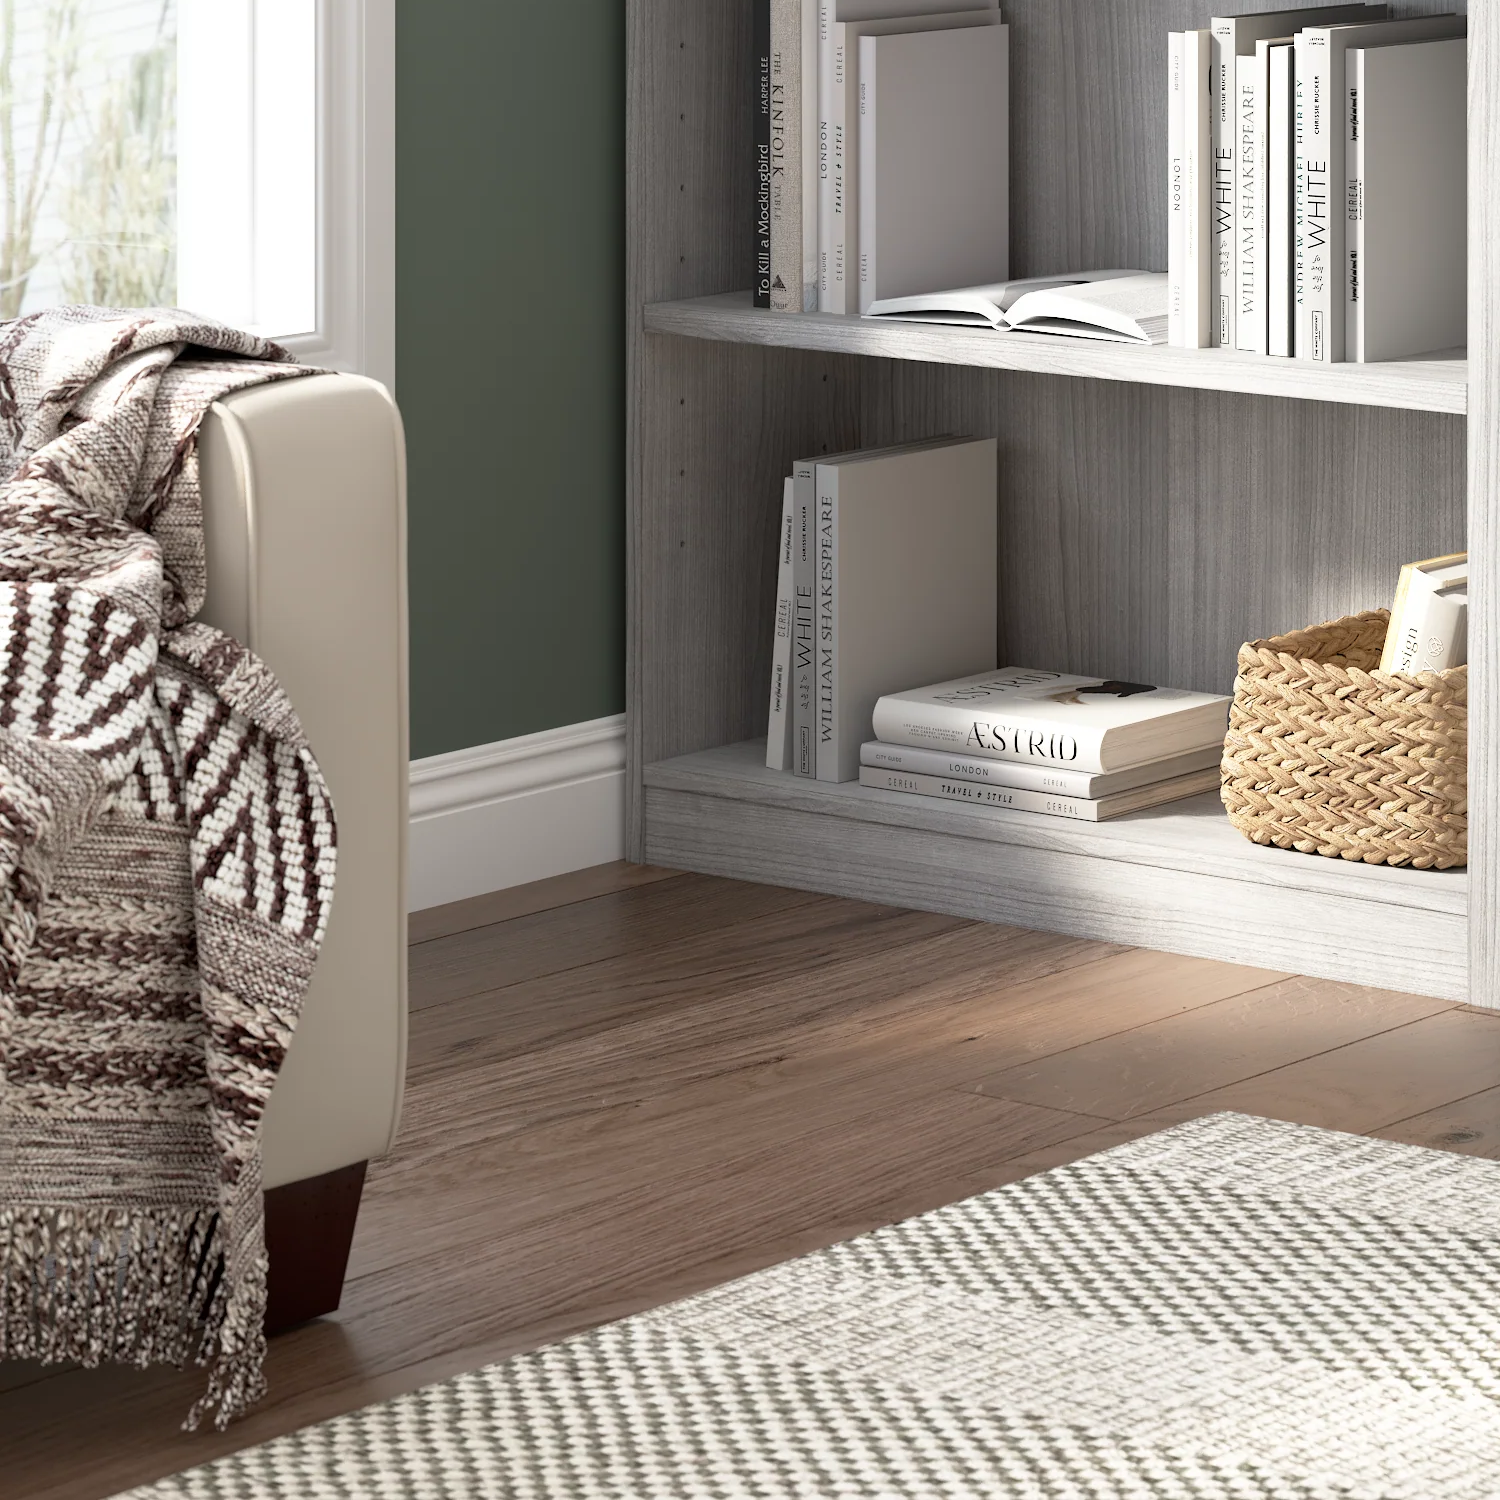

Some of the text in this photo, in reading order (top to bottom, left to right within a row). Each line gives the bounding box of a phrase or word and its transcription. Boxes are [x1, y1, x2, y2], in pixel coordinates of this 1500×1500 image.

[1216, 148, 1231, 235] WHITE
[1308, 160, 1326, 249] WHITE
[797, 586, 812, 669] WHITE
[942, 785, 972, 797] TRAVEL
[987, 792, 1013, 804] STYLE
[949, 764, 989, 776] LONDON
[1047, 802, 1078, 815] CEREAL
